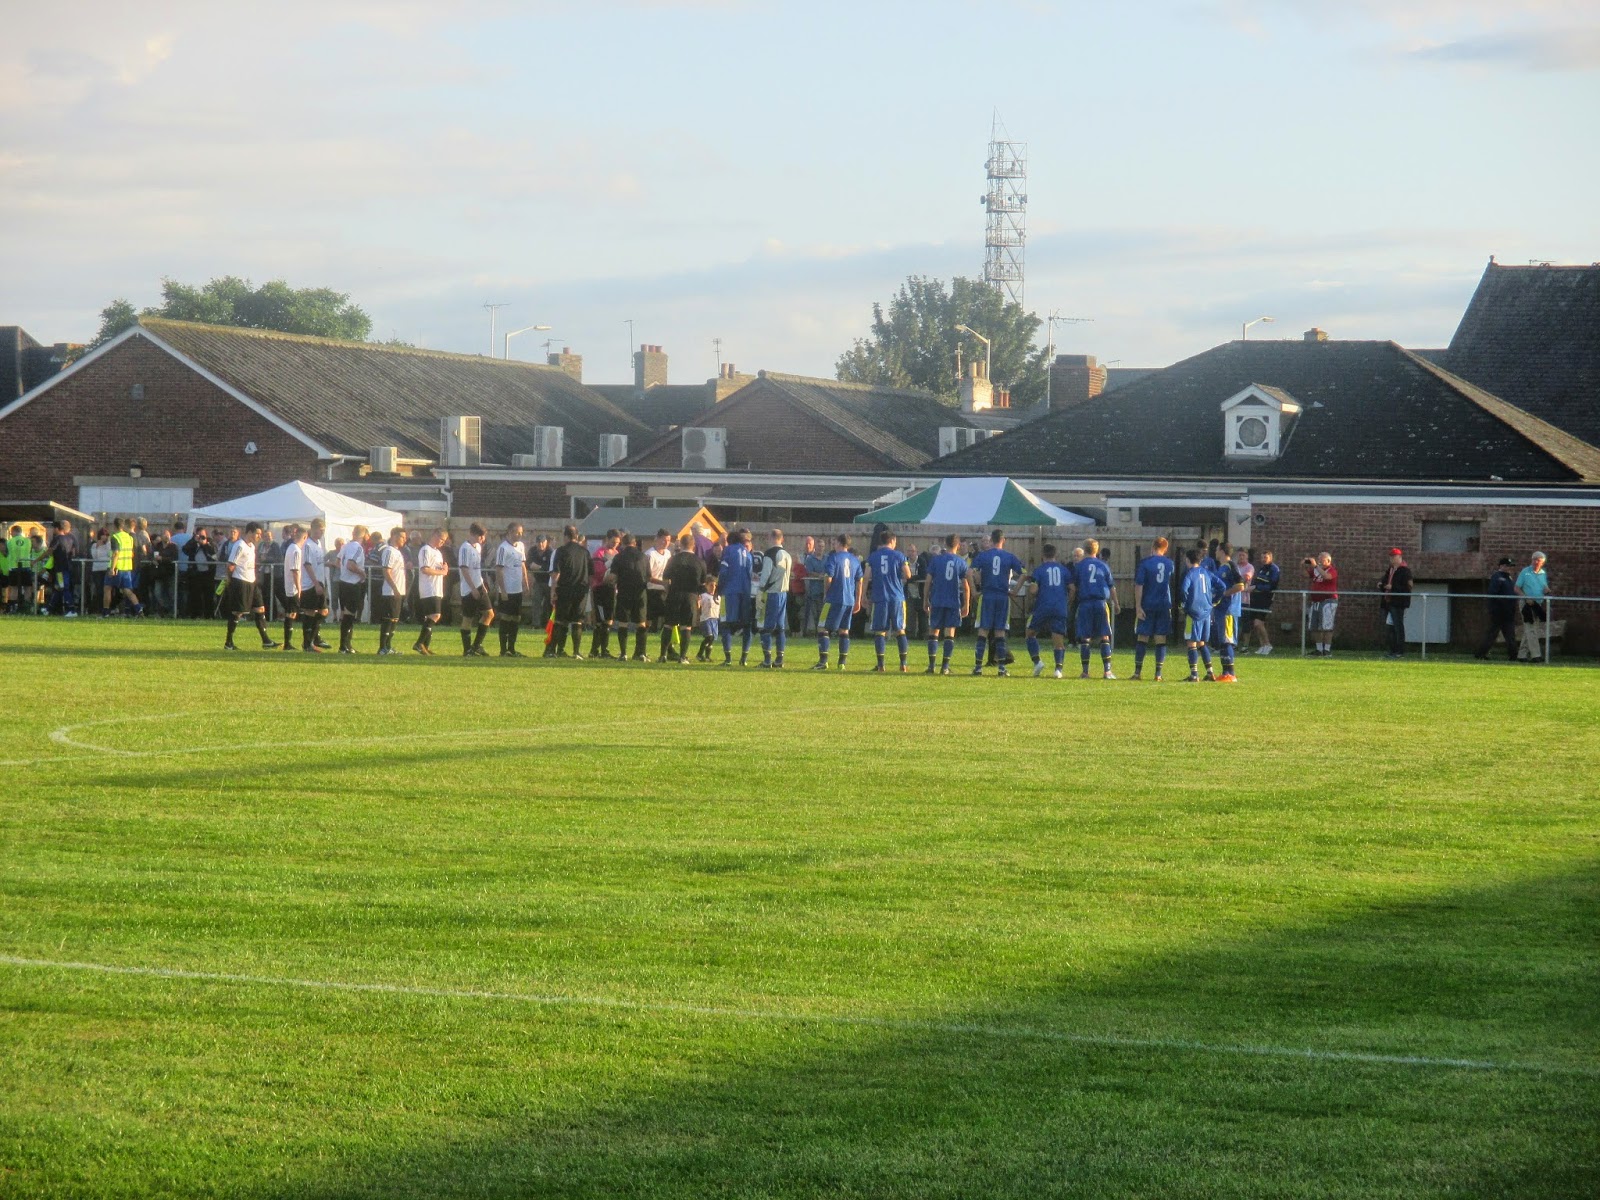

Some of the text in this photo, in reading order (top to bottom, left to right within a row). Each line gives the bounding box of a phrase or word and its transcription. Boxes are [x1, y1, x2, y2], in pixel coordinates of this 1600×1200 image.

[844, 558, 850, 578] 8
[881, 555, 888, 574] 5
[945, 560, 954, 581] 6
[992, 556, 1001, 576] 9
[1088, 563, 1096, 583] 2
[1157, 563, 1165, 584] 3
[1046, 567, 1061, 586] 10
